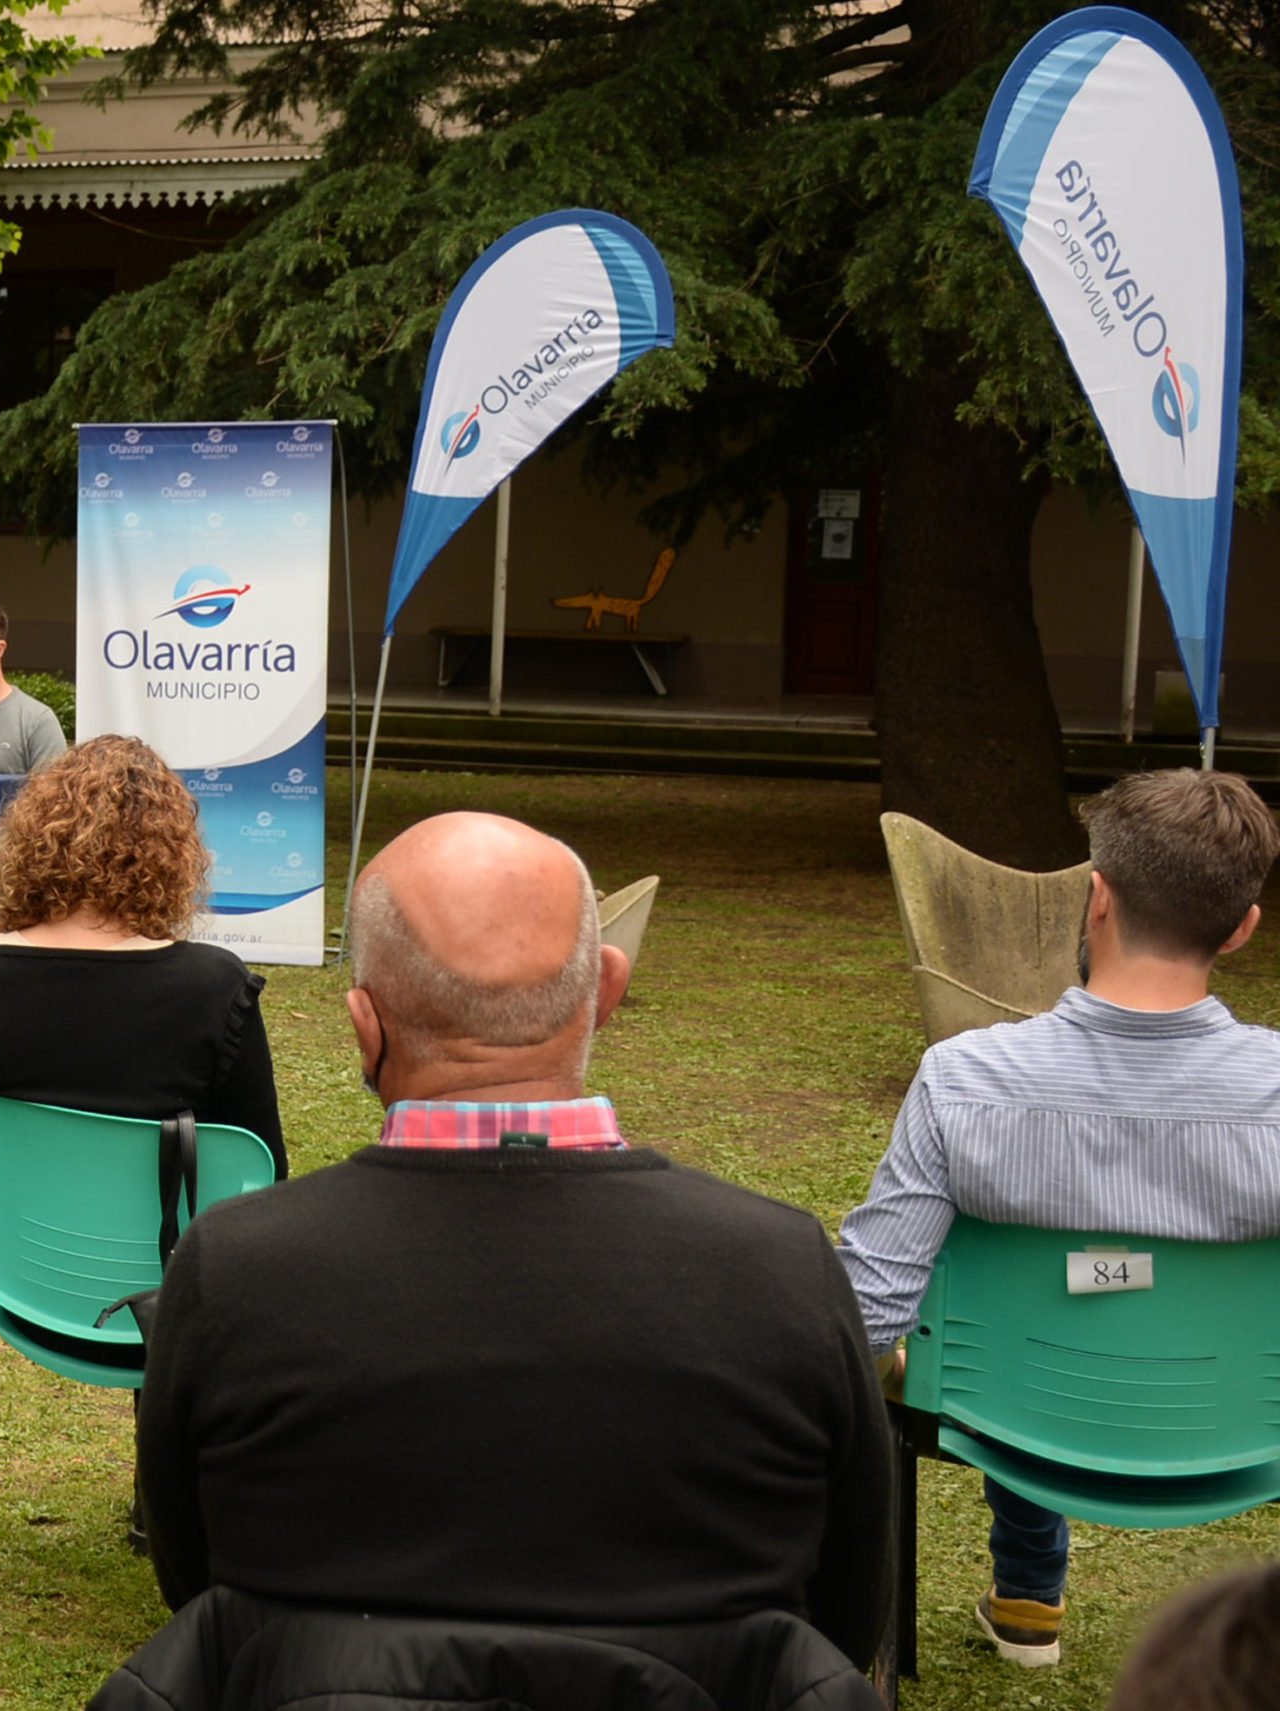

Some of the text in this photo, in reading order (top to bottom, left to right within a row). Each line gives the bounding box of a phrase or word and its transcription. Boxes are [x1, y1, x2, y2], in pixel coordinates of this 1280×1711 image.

[481, 308, 603, 415] Olavarría
[524, 344, 595, 410] MUNICIPIO
[103, 629, 296, 673] Olavarría
[146, 681, 261, 700] MUNICIPIO
[1093, 1260, 1130, 1286] 84
